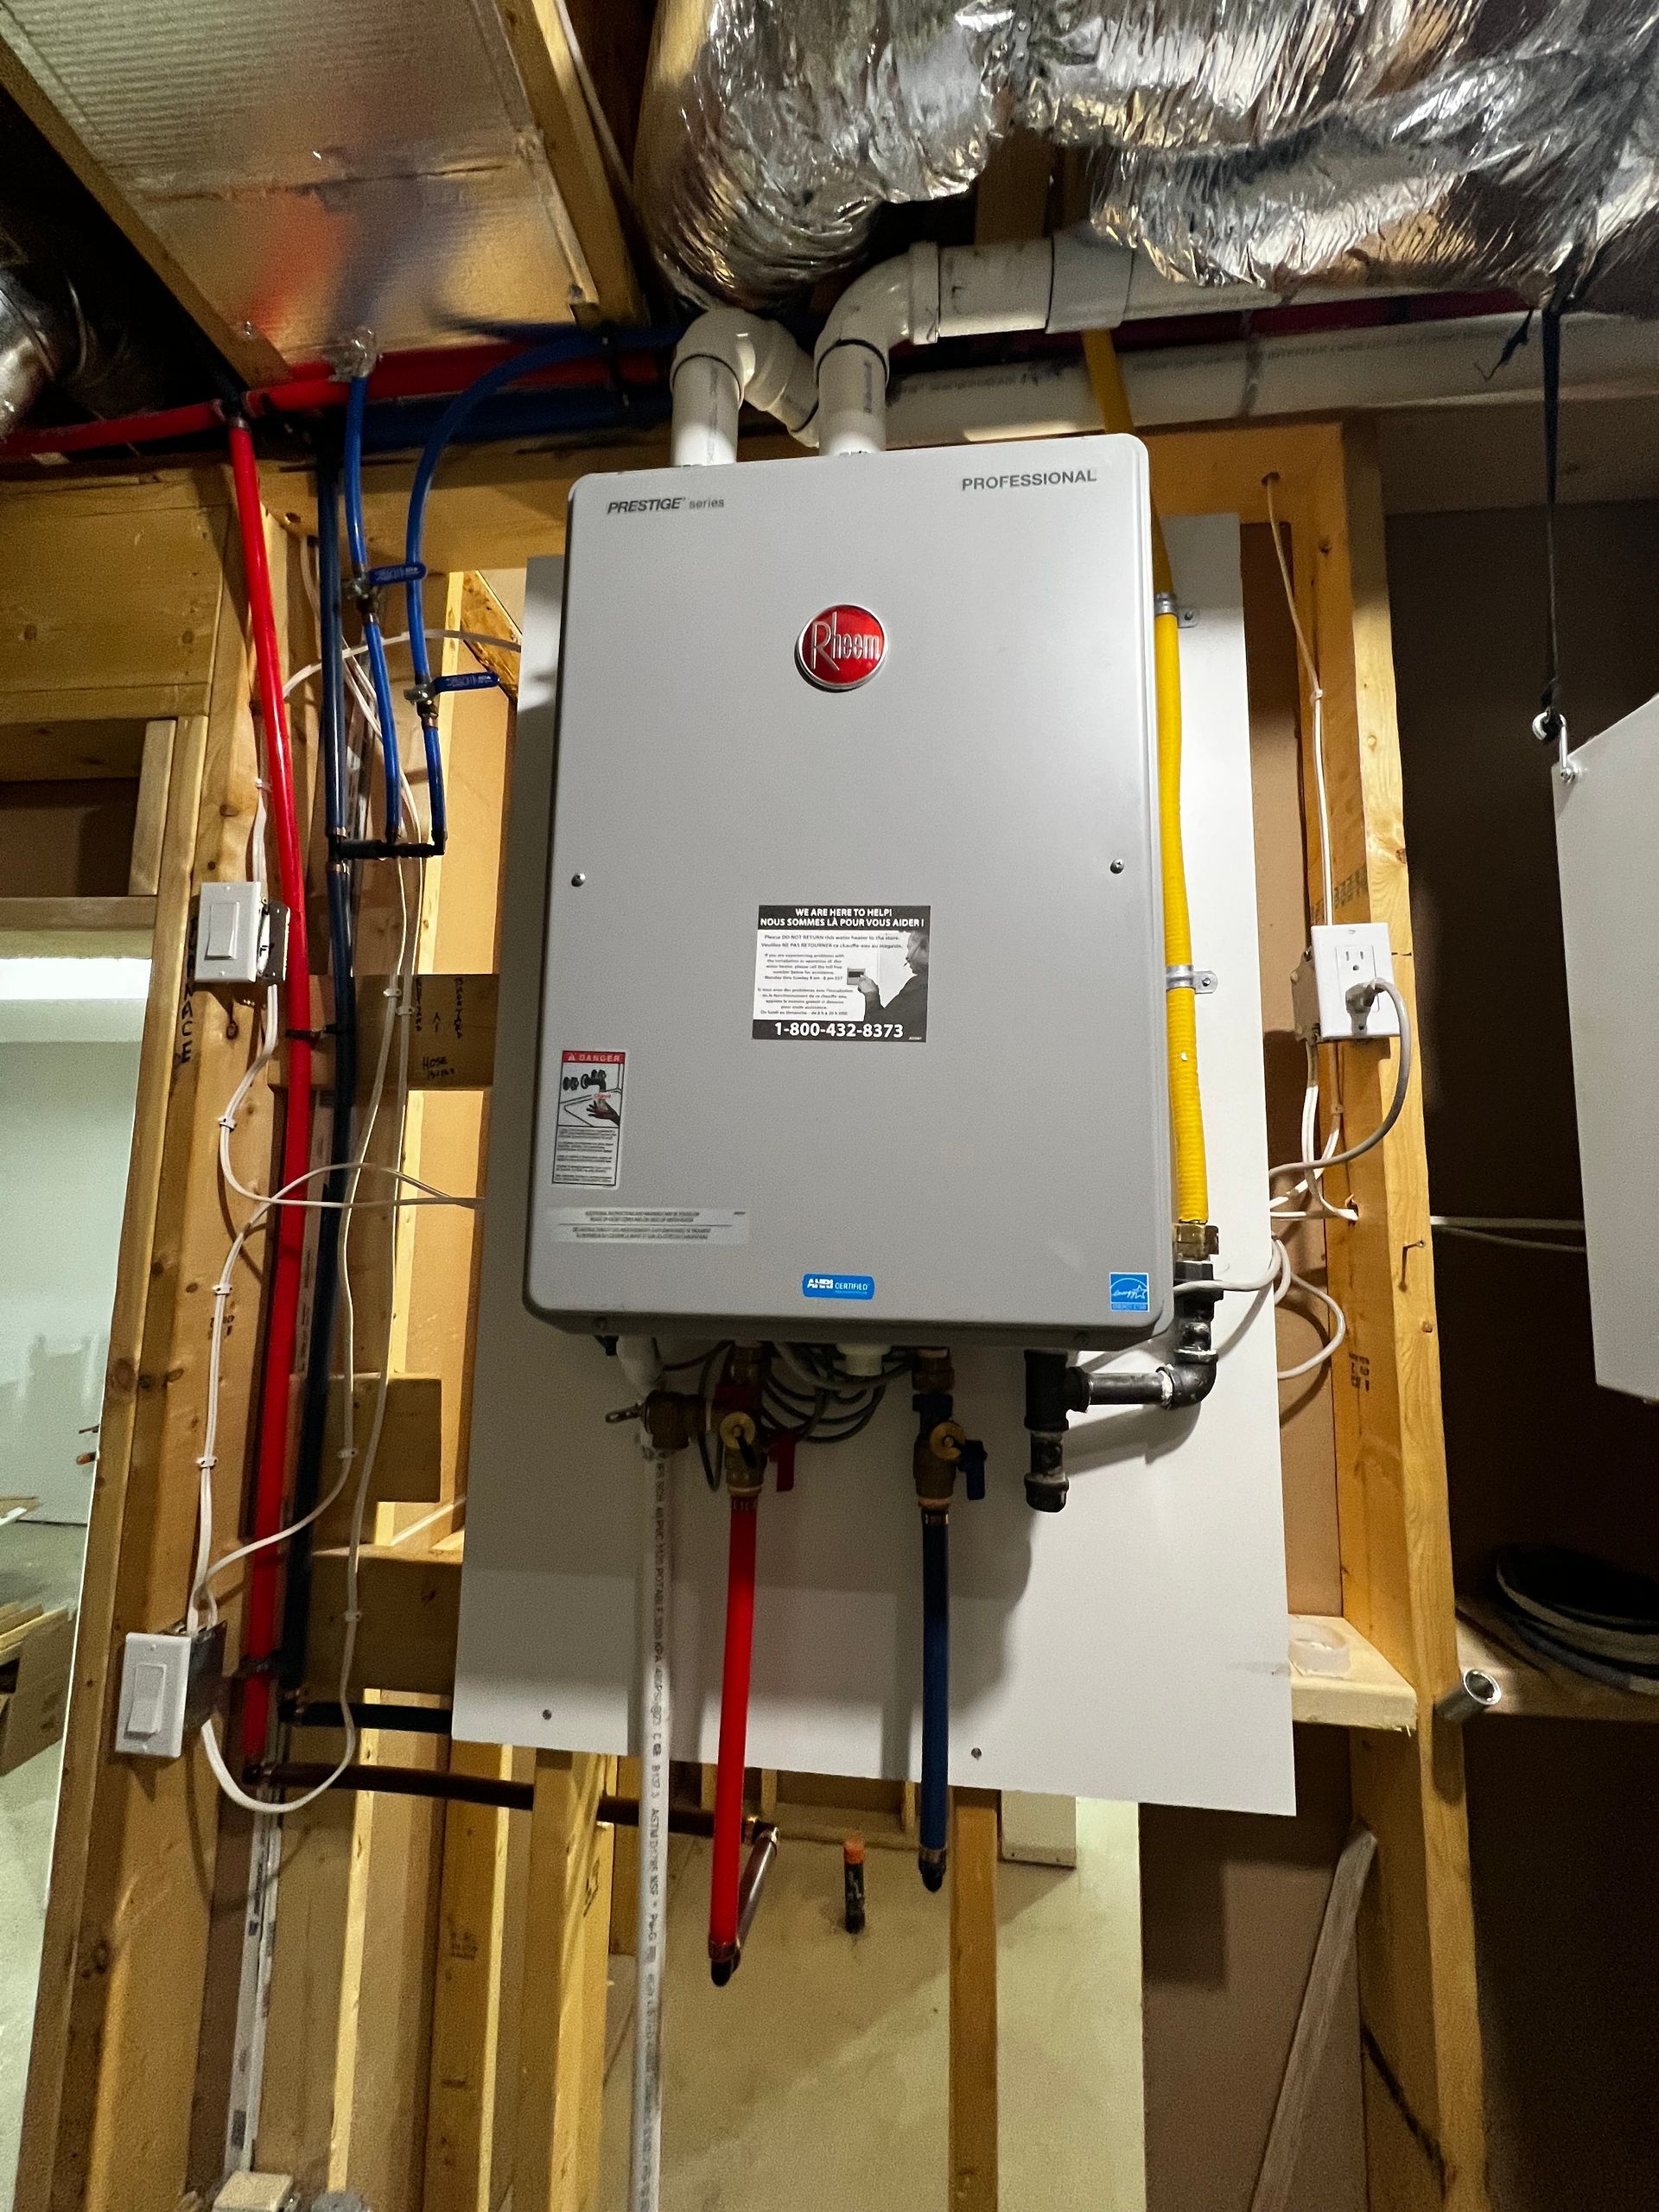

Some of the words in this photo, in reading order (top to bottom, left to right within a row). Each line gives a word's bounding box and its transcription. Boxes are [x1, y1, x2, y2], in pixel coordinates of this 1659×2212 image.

[962, 470, 1096, 491] PROFESSIONAL
[607, 498, 683, 514] PRESTIGE
[690, 499, 724, 509] series
[810, 611, 880, 671] Rheem
[795, 908, 810, 917] WE
[810, 908, 828, 917] ARE
[830, 908, 852, 917] HERE
[854, 908, 866, 917] TO
[760, 918, 785, 926] NOUS
[787, 918, 825, 927] SOMMES
[827, 917, 838, 927] LÀ
[840, 918, 865, 927] POUR
[866, 918, 891, 927] VOUS
[774, 1021, 903, 1038] 1-800-432-8373
[579, 1053, 620, 1062] DANGER
[835, 1282, 868, 1291] CERTIFIED
